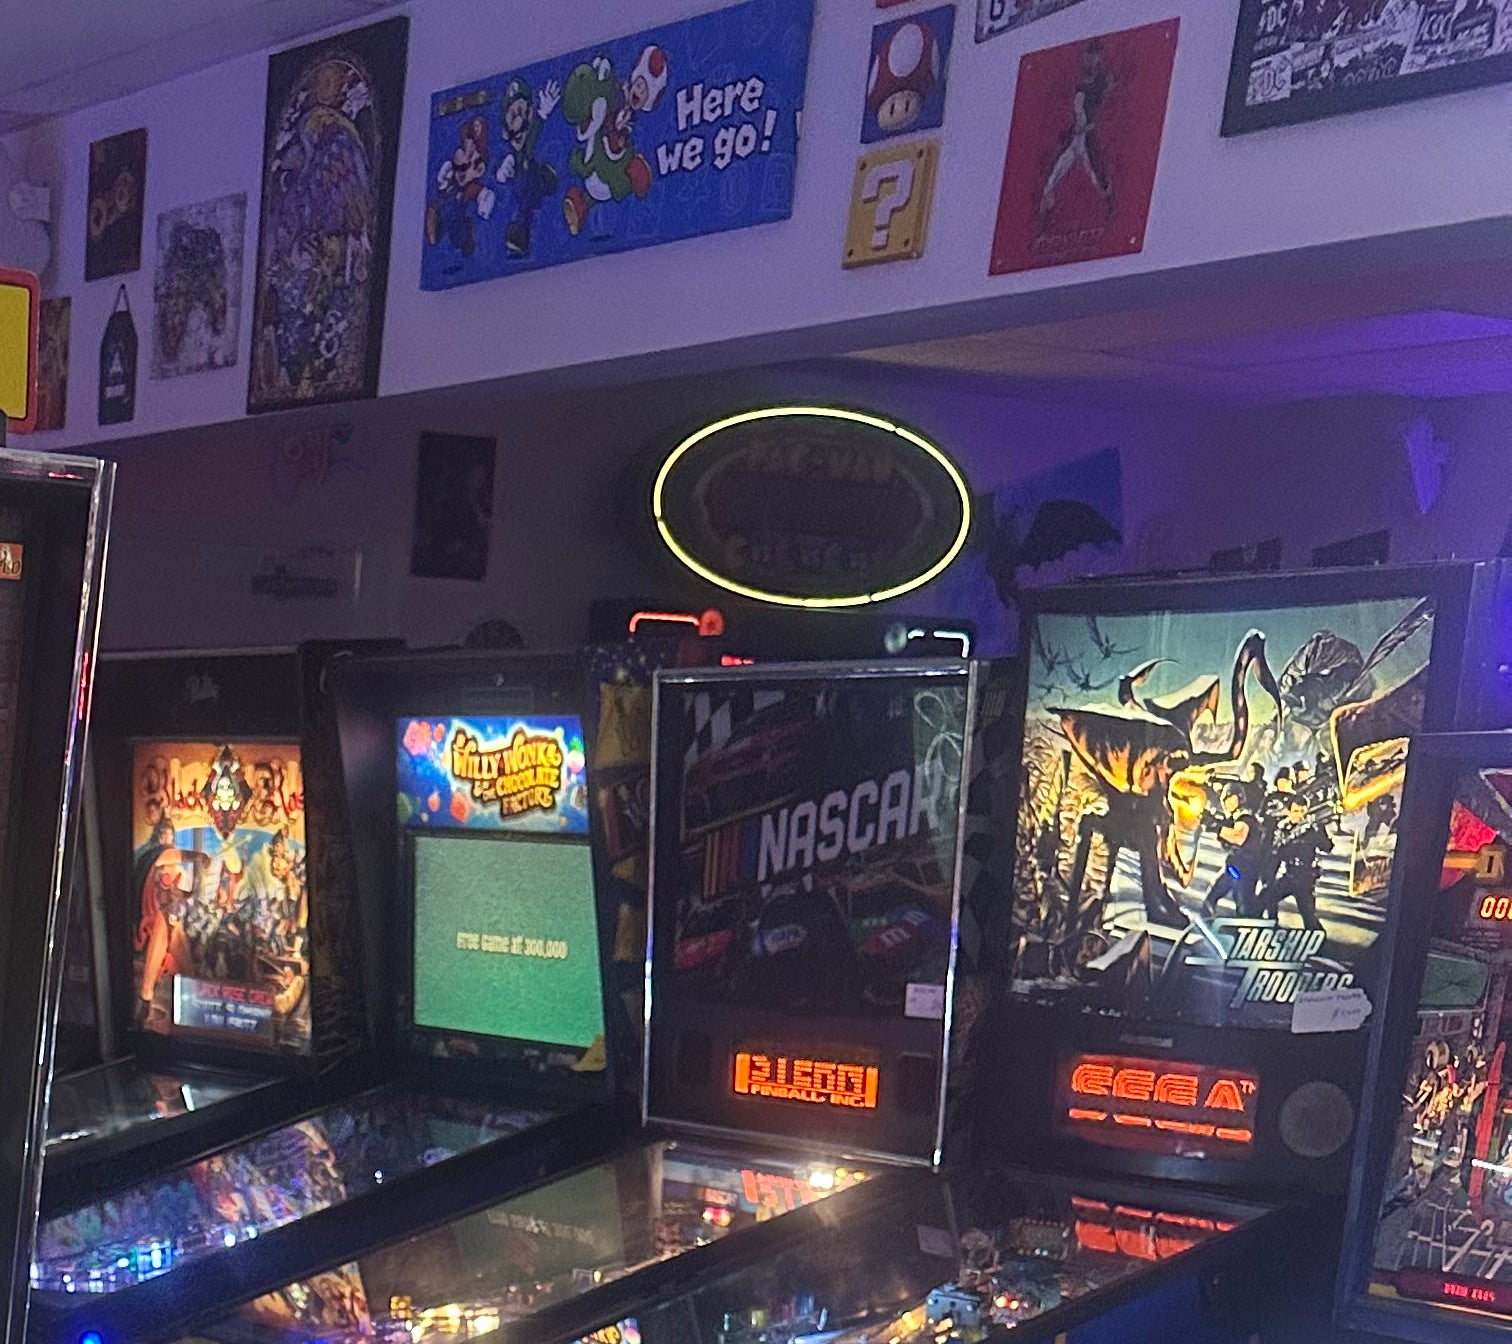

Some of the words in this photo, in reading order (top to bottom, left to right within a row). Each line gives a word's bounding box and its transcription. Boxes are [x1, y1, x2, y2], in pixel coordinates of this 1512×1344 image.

[676, 76, 764, 131] Here
[657, 138, 702, 176] we
[712, 109, 777, 171] go!
[452, 729, 501, 779] WILLY
[757, 760, 941, 882] NASCAR
[1185, 917, 1326, 967] STARSHIP
